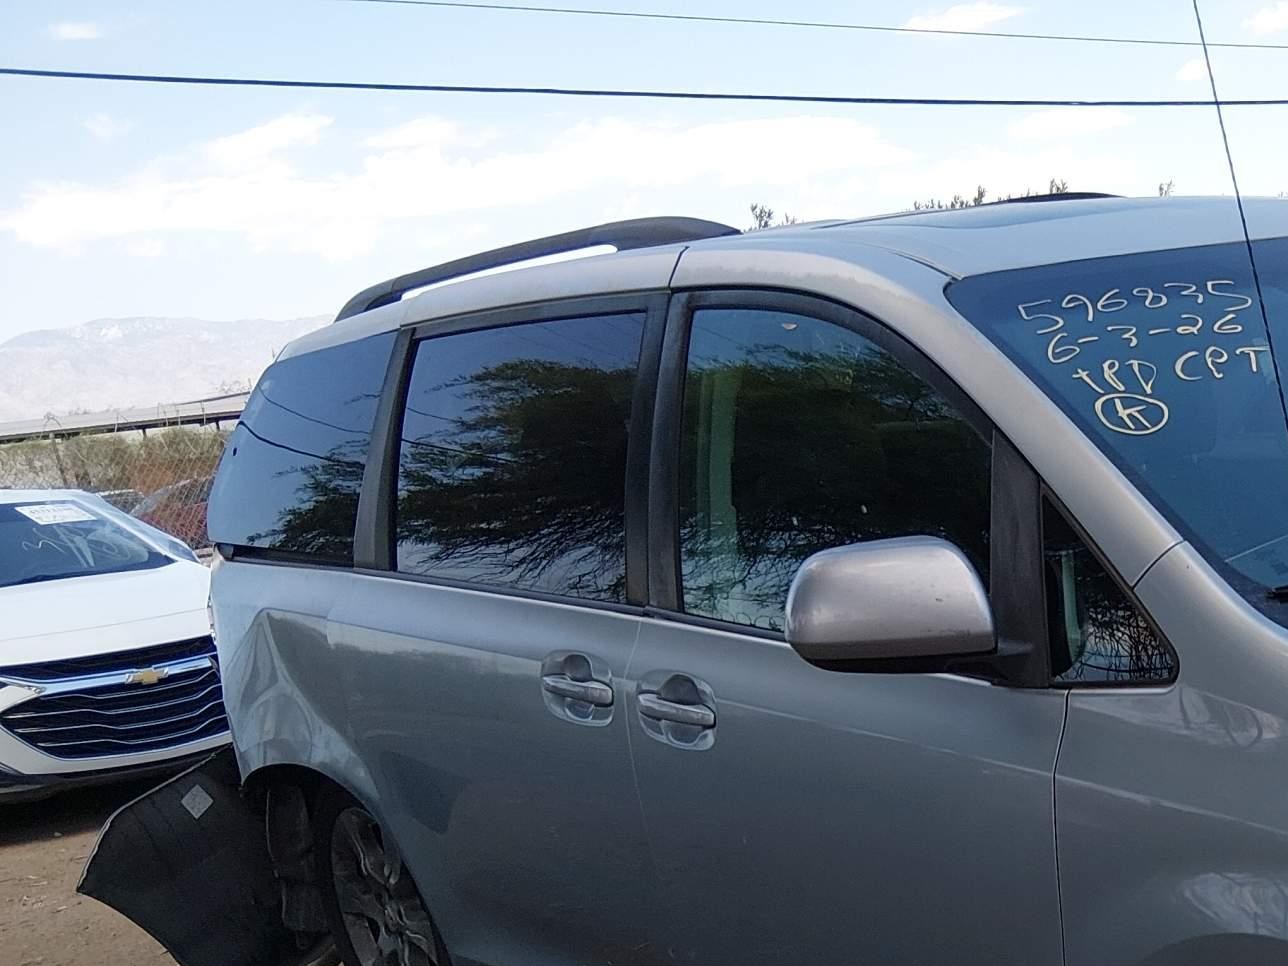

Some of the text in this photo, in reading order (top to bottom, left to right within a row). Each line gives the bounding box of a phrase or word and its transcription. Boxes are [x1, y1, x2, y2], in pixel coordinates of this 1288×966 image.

[1018, 280, 1252, 334] 596835
[1047, 313, 1243, 364] 6-3-26
[1174, 345, 1272, 381] CPT
